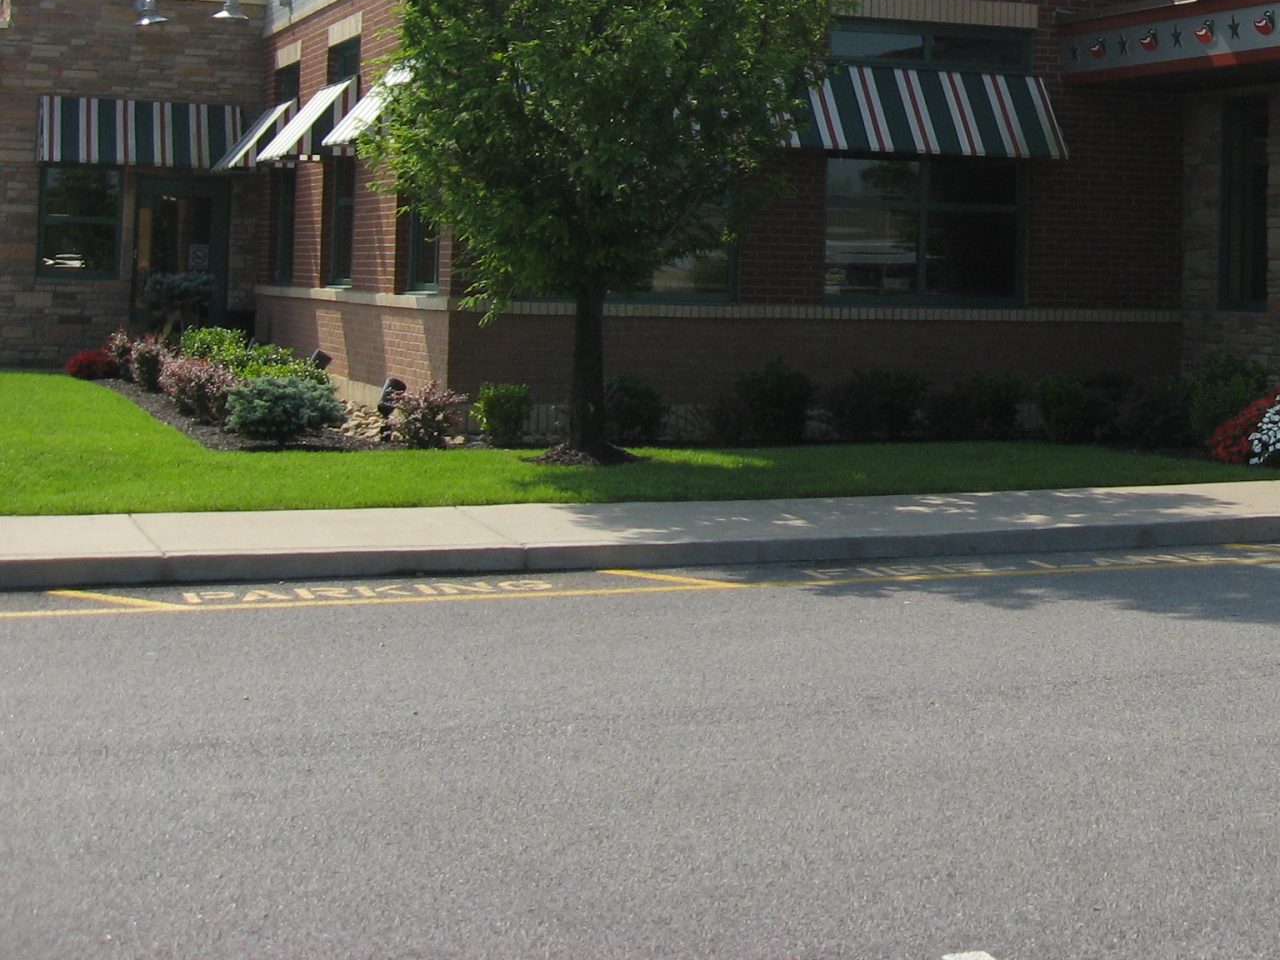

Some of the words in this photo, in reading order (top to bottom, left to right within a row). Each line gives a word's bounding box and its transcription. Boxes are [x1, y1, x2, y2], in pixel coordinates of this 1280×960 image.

[801, 562, 1010, 580] FIRE
[1026, 552, 1237, 568] LANE
[180, 579, 554, 604] PARKING
